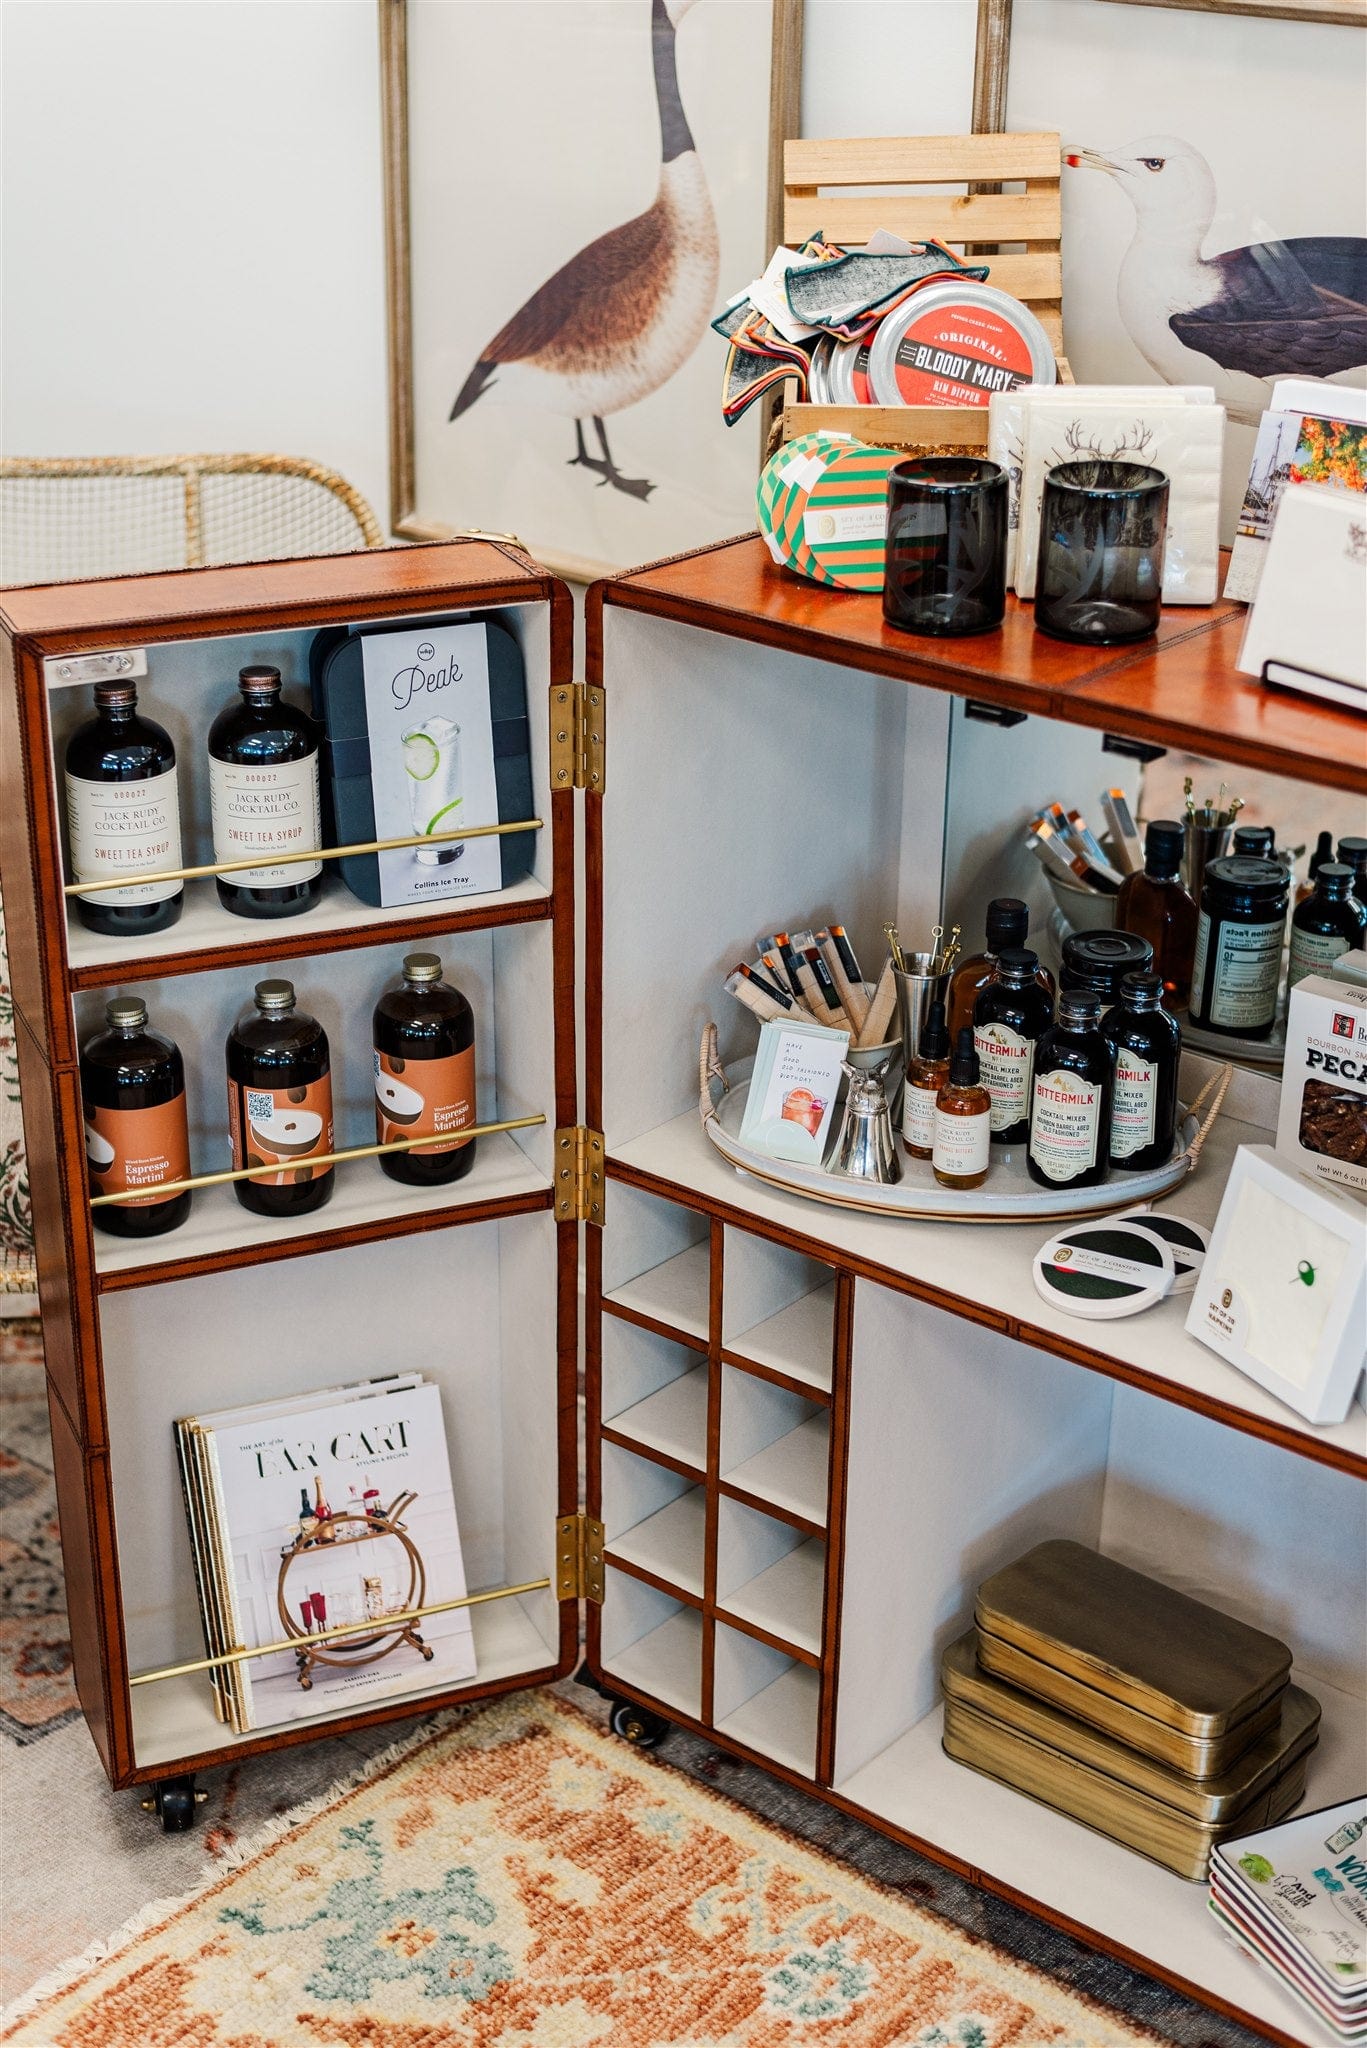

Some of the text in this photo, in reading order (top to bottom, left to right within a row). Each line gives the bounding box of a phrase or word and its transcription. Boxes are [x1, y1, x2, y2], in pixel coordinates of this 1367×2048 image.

[940, 332, 1003, 360] ORIGINAL
[914, 346, 1014, 392] BLOODY MARY
[933, 381, 980, 404] RIM DIPPER
[392, 655, 464, 710] Peak
[236, 792, 291, 803] JACK RUDY
[104, 807, 160, 822] JACK RUDY
[228, 803, 280, 814] COCKTAIL
[94, 821, 150, 831] COCKTAIL
[228, 827, 302, 842] SWEET TEA SYRUP
[95, 842, 170, 860] SWEET TEA SYRUP
[414, 881, 438, 889] Collins
[786, 1042, 802, 1050] HAVE
[974, 1036, 1028, 1058] BITTERMILK
[1308, 1036, 1350, 1056] BOURBON
[797, 1067, 830, 1078] FASHIONED
[1000, 1066, 1020, 1074] MIXER
[780, 1073, 812, 1083] BIRTHDAY
[988, 1080, 1014, 1089] FASHIONED
[991, 1074, 1008, 1082] BARREL
[1037, 1084, 1094, 1104] BITTERMILK
[434, 1104, 469, 1121] Espresso
[1040, 1108, 1064, 1120] COCKTAIL
[434, 1115, 466, 1131] Martini
[1036, 1116, 1055, 1126] BOURBON
[1056, 1122, 1074, 1131] BARREL
[1052, 1128, 1080, 1137] FASHIONED
[126, 1160, 170, 1174] Espresso
[1317, 1164, 1330, 1173] Net
[126, 1171, 164, 1184] Martini
[1108, 1260, 1141, 1272] COASTERS
[1210, 1302, 1218, 1312] SET
[1208, 1312, 1232, 1334] NAPKINS
[330, 1419, 412, 1462] CART
[1291, 1882, 1316, 1900] And
